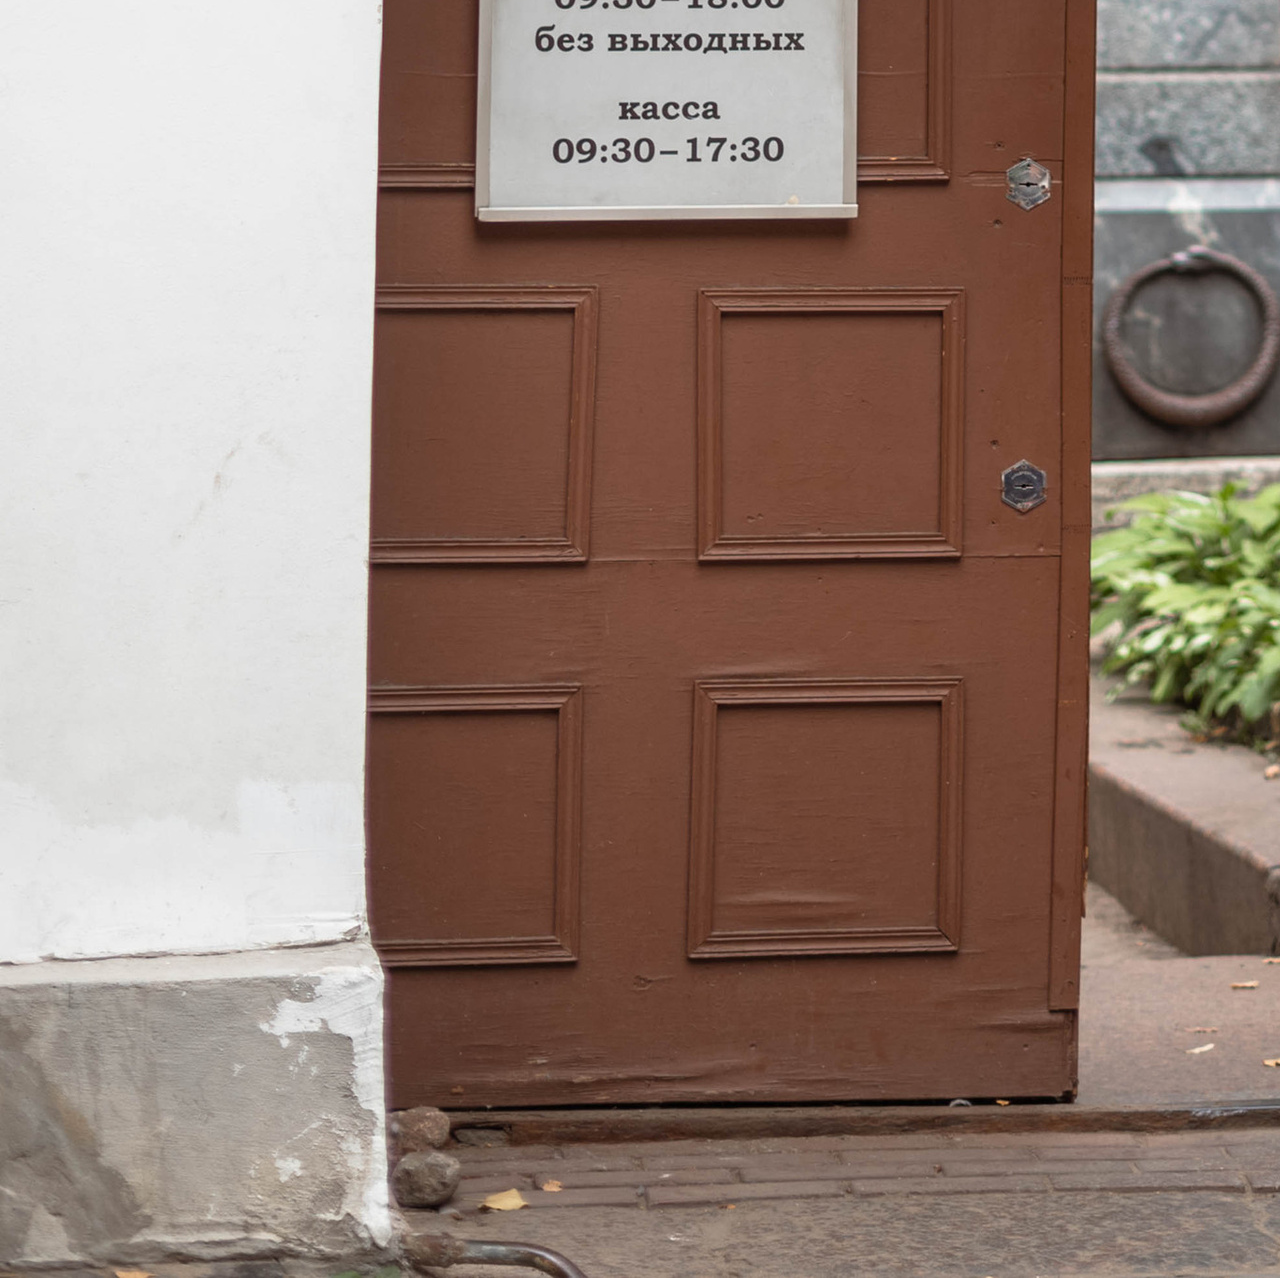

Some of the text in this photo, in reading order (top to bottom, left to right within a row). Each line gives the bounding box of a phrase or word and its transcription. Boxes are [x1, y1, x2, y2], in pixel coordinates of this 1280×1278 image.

[534, 24, 806, 54] без выходных
[617, 100, 721, 120] касса
